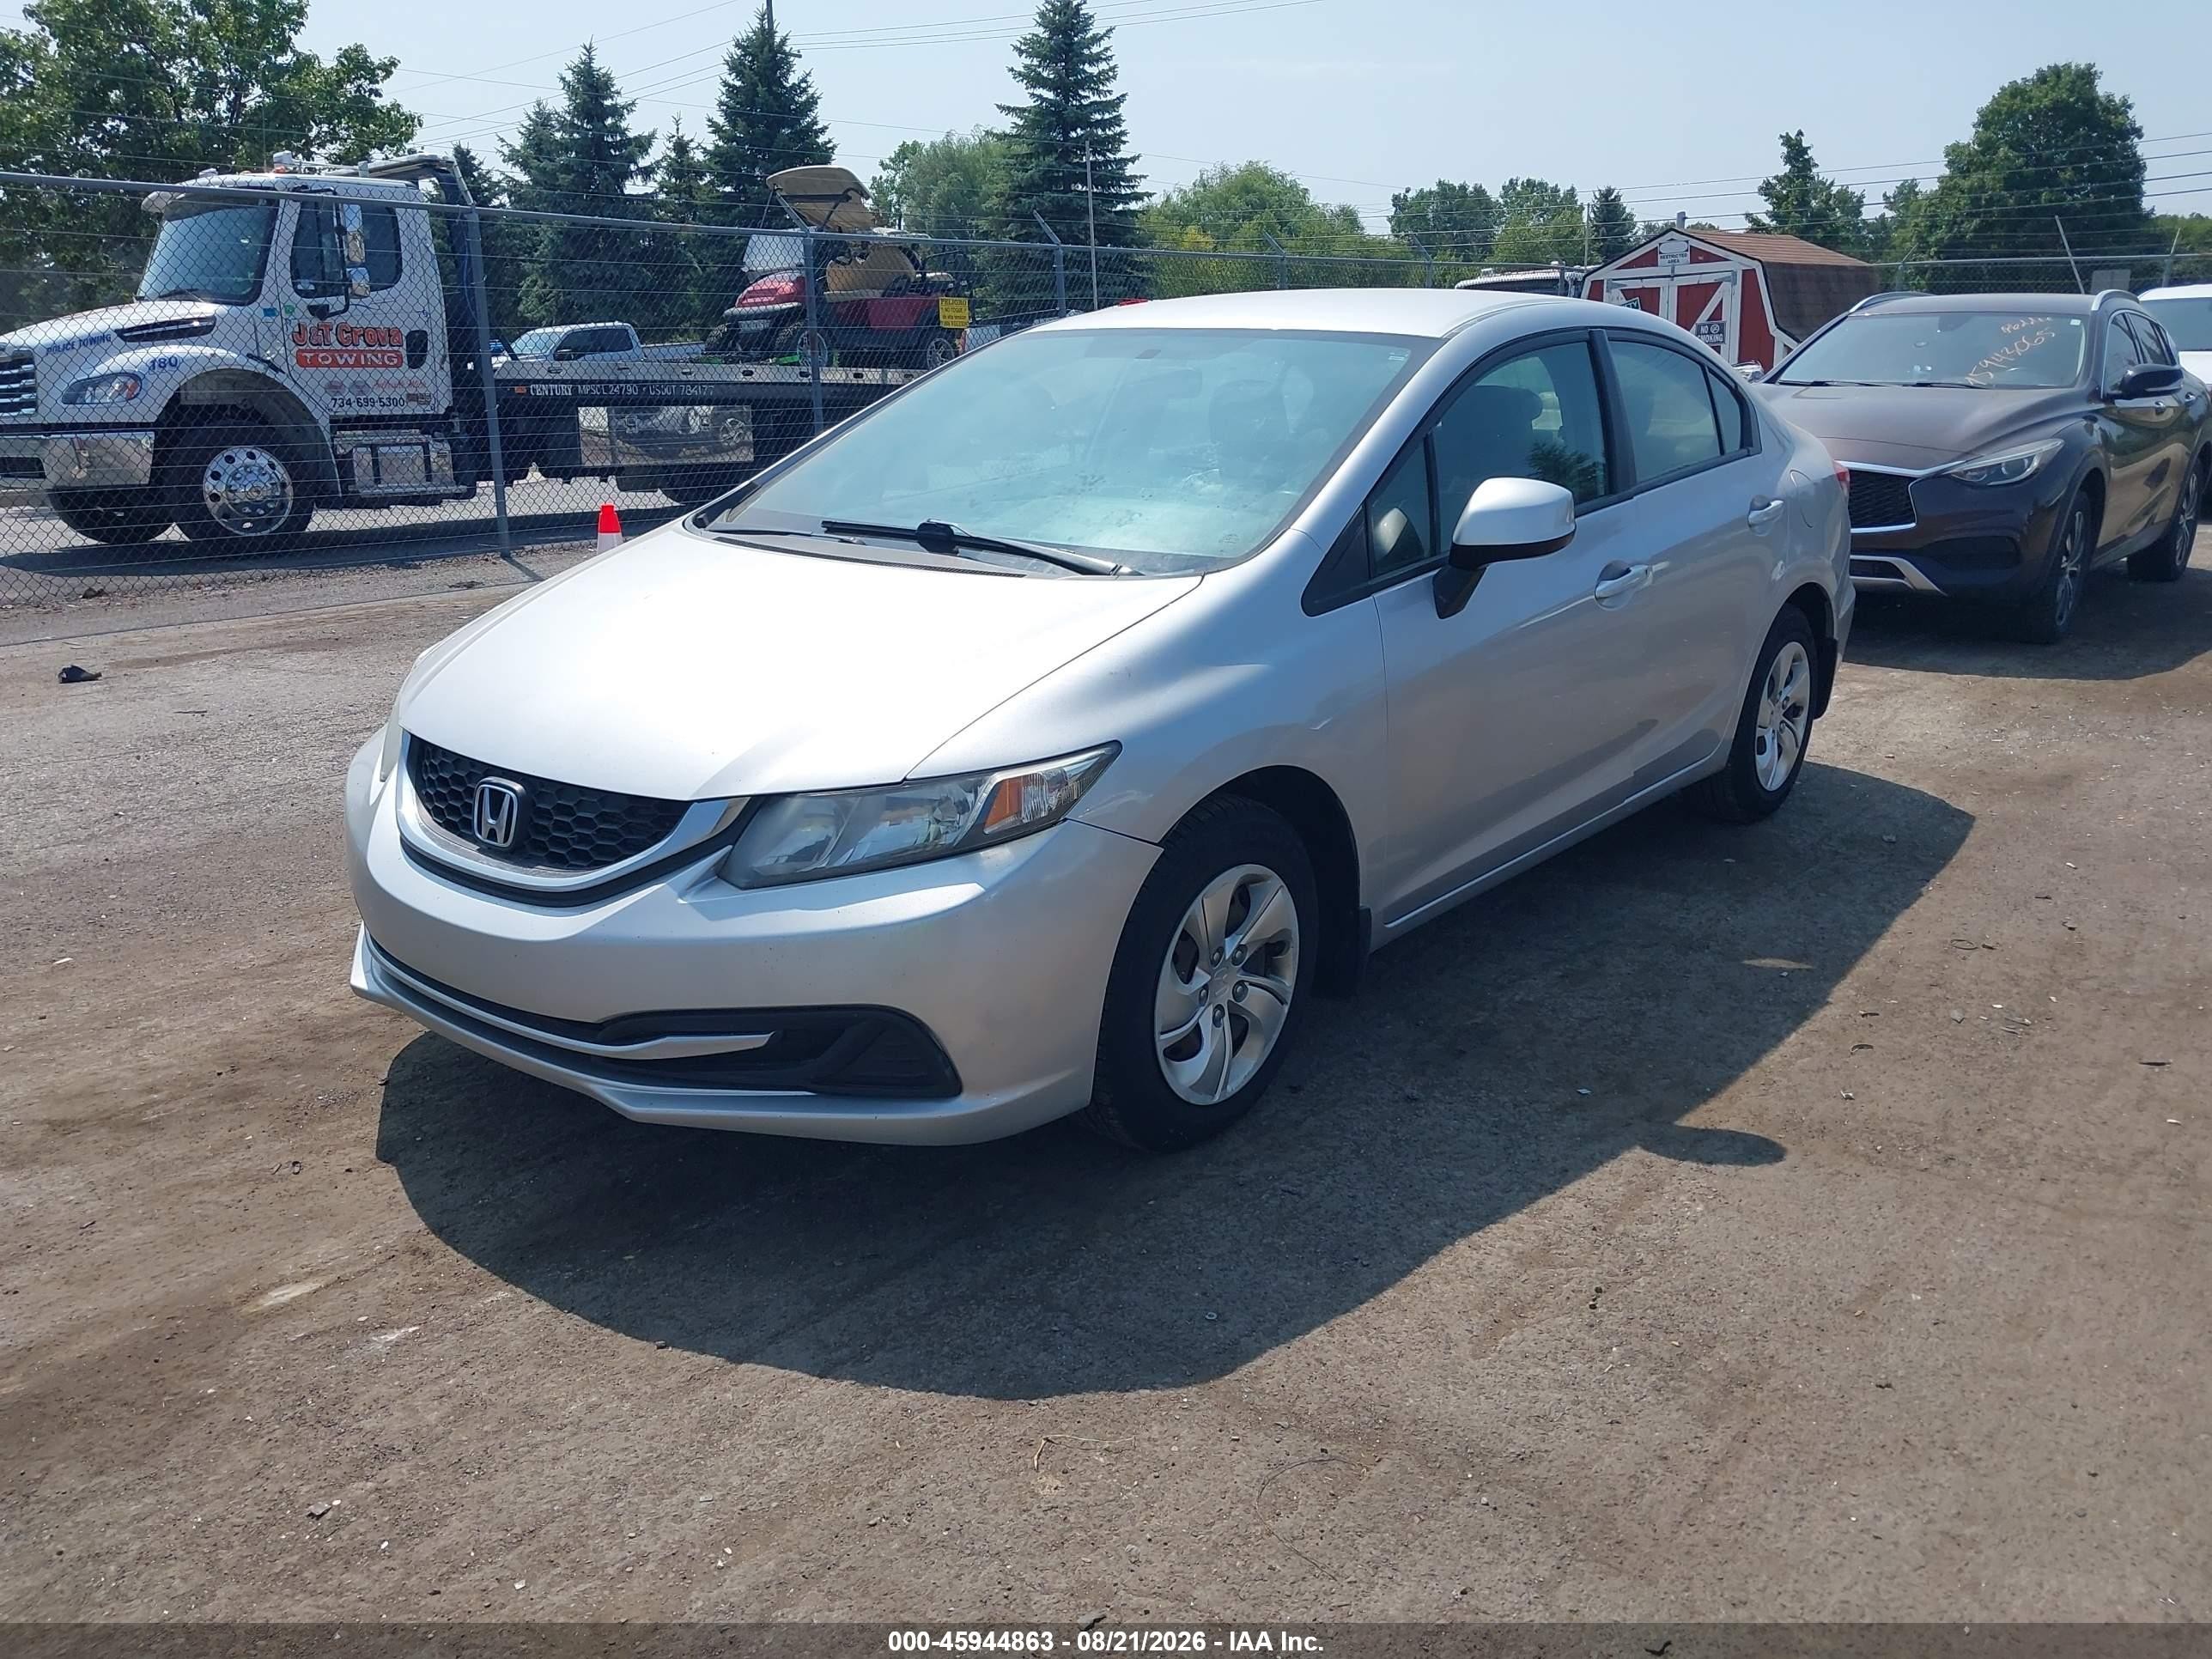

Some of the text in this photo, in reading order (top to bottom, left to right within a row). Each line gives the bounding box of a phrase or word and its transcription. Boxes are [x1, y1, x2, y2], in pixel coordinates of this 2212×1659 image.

[292, 321, 404, 347] J&T Crova
[1700, 325, 1709, 334] NO
[46, 333, 112, 356] POLICE TOWING
[149, 356, 179, 371] 180
[301, 352, 398, 366] TOWING
[530, 384, 573, 396] CENTURY
